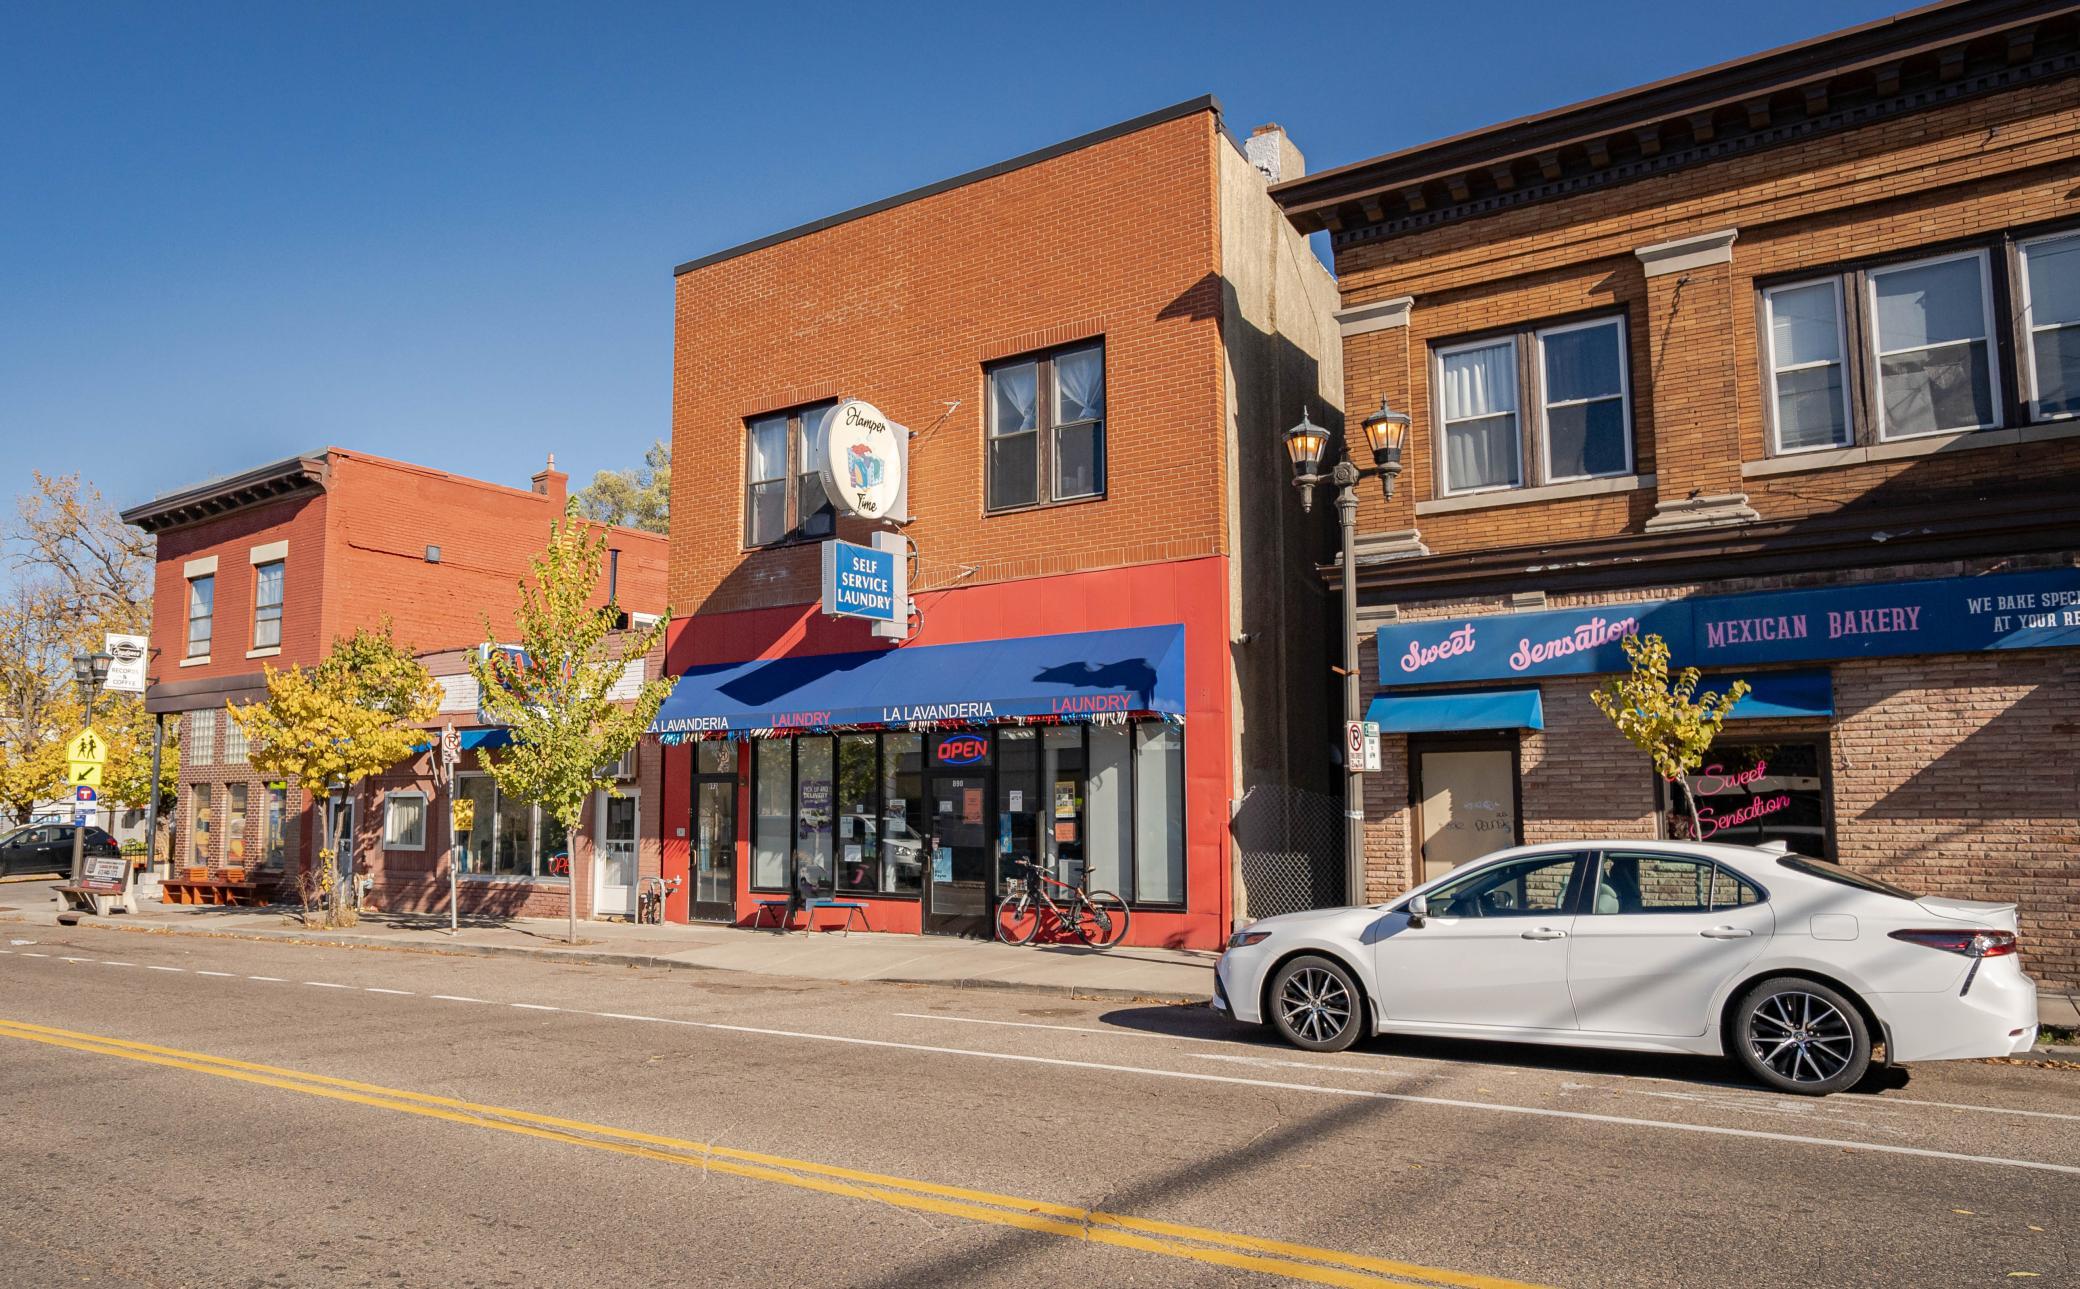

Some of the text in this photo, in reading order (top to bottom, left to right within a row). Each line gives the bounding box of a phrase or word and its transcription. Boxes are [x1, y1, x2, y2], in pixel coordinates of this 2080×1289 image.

[846, 406, 886, 434] Hamper
[856, 492, 877, 513] Time
[852, 557, 878, 574] SELF
[841, 571, 888, 593] SERVICE
[837, 588, 892, 610] LAUNDRY
[1966, 597, 1993, 615] WE
[1997, 594, 2036, 611] BAKE
[1706, 606, 1922, 648] MEXICAN BAKERY
[1993, 615, 2012, 632] AT
[2018, 612, 2058, 629] YOUR
[1400, 616, 1641, 673] Sweet Sensation
[661, 716, 729, 732] LAVANDERIA
[772, 711, 831, 727] LAUNDRY
[883, 707, 900, 722] LA
[904, 702, 994, 721] LAVANDERIA
[1052, 694, 1132, 713] LAUNDRY
[937, 740, 987, 760] OPEN
[952, 780, 964, 788] 890
[1696, 759, 1767, 796] Sweet
[1690, 794, 1790, 839] Sensation
